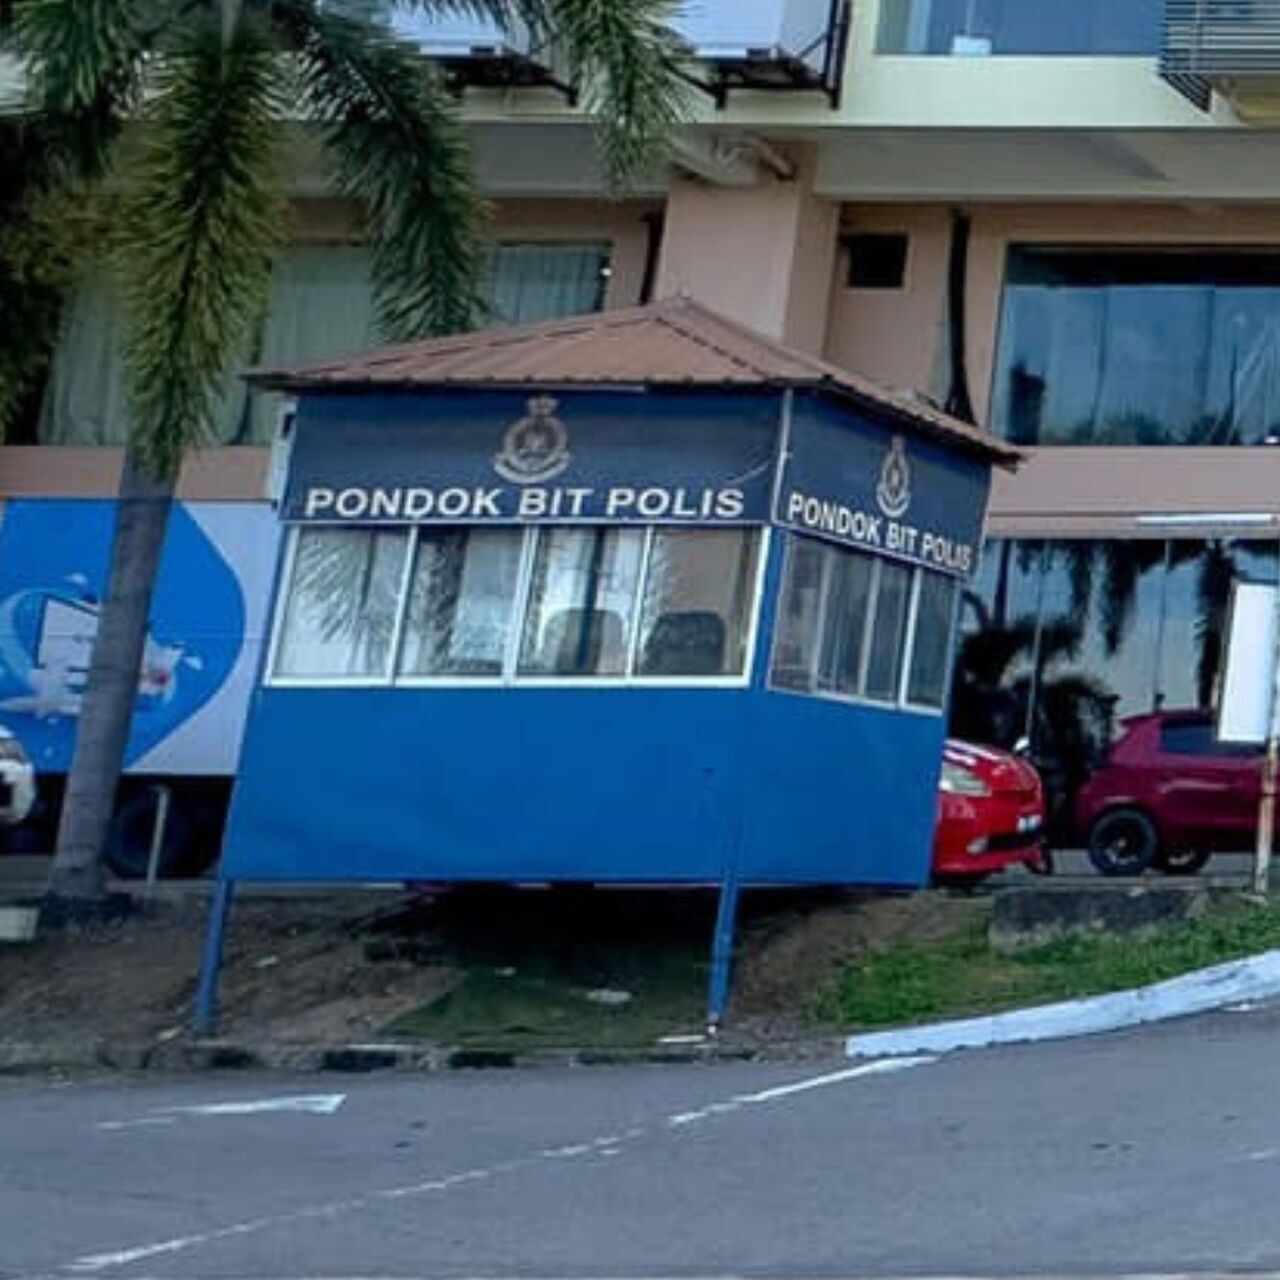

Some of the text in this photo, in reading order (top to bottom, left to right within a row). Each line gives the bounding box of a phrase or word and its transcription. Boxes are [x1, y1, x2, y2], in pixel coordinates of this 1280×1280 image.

[304, 487, 745, 517] PONDOK BIT POLIS
[788, 492, 972, 570] PONDOK BIT POLIS
